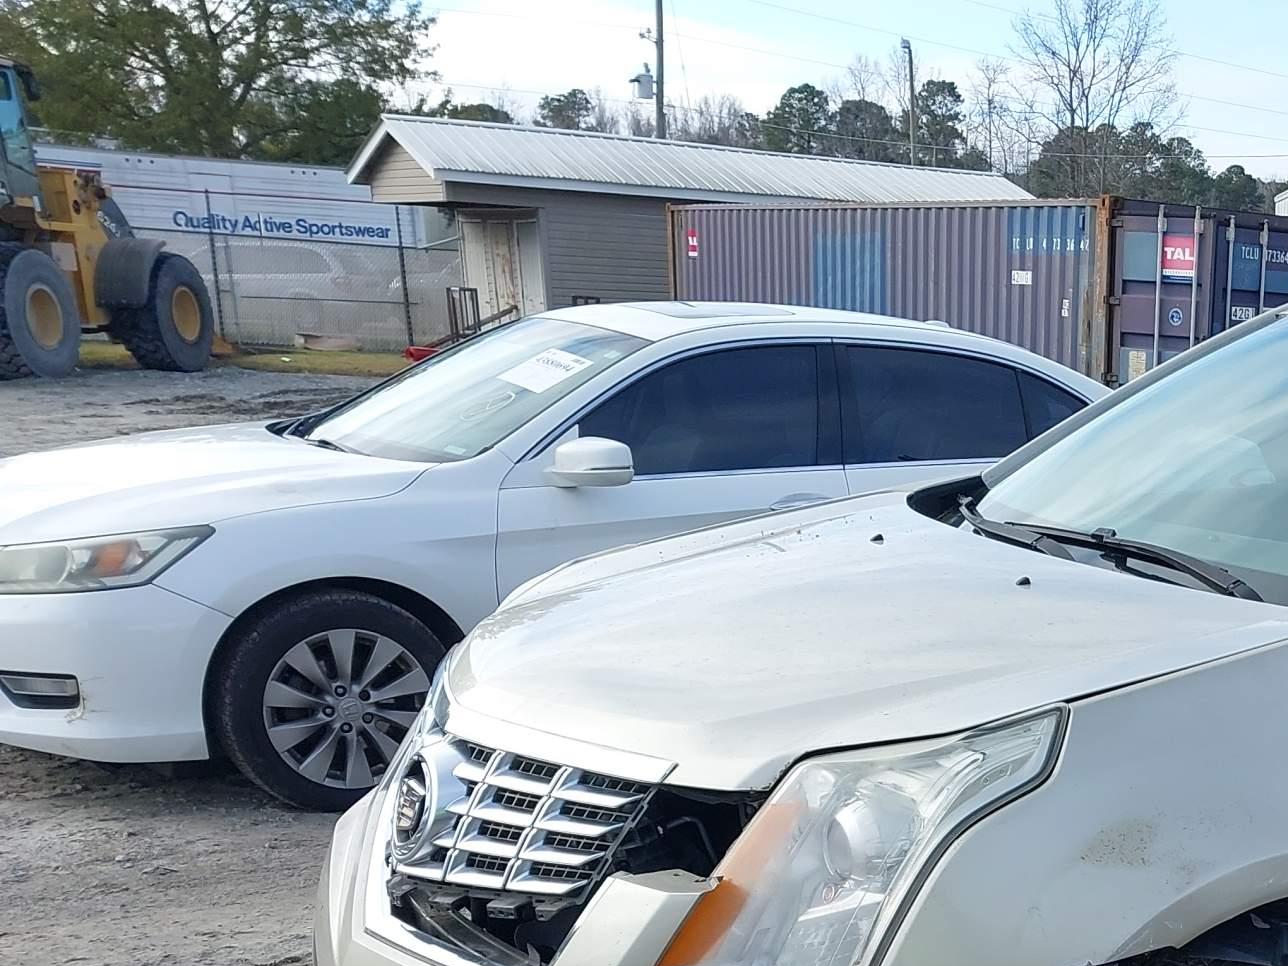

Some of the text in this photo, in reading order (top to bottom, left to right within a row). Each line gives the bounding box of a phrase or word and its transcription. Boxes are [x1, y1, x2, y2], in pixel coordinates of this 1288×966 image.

[172, 210, 391, 239] Quality Active Sportswear
[1164, 247, 1194, 260] TAL
[1241, 246, 1259, 260] TCLU
